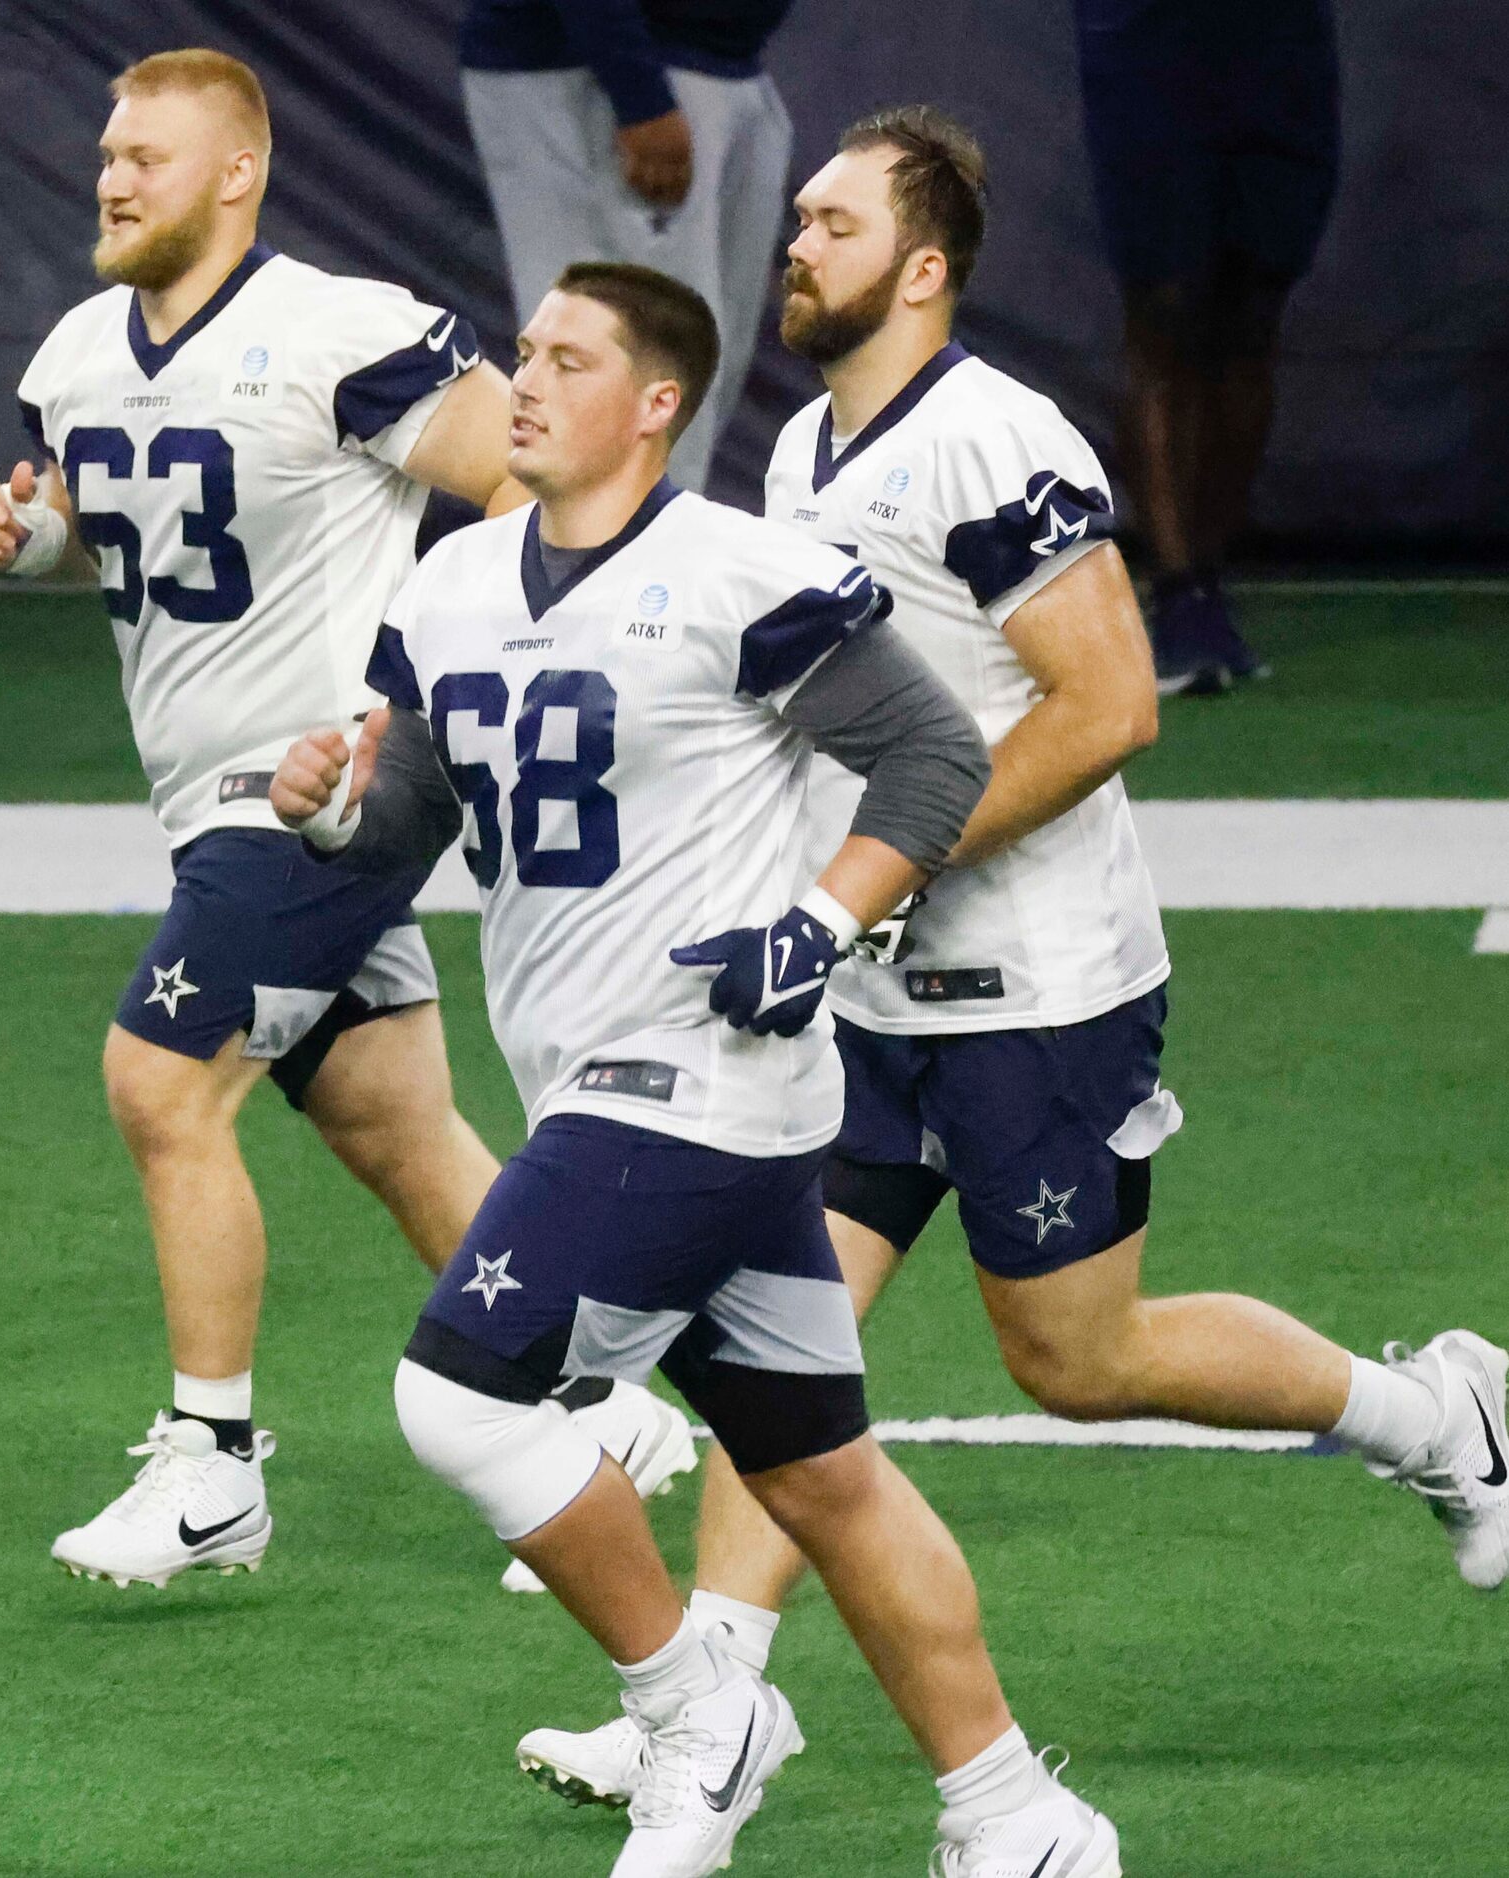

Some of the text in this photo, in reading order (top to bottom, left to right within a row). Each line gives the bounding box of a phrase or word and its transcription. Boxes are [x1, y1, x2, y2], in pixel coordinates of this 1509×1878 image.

[233, 383, 269, 398] AT&T
[123, 396, 171, 408] COWBOYS
[867, 501, 900, 521] AT&T
[62, 427, 254, 627] 63
[626, 623, 667, 640] AT&T
[502, 637, 555, 652] COWBOYS
[430, 670, 621, 889] 68
